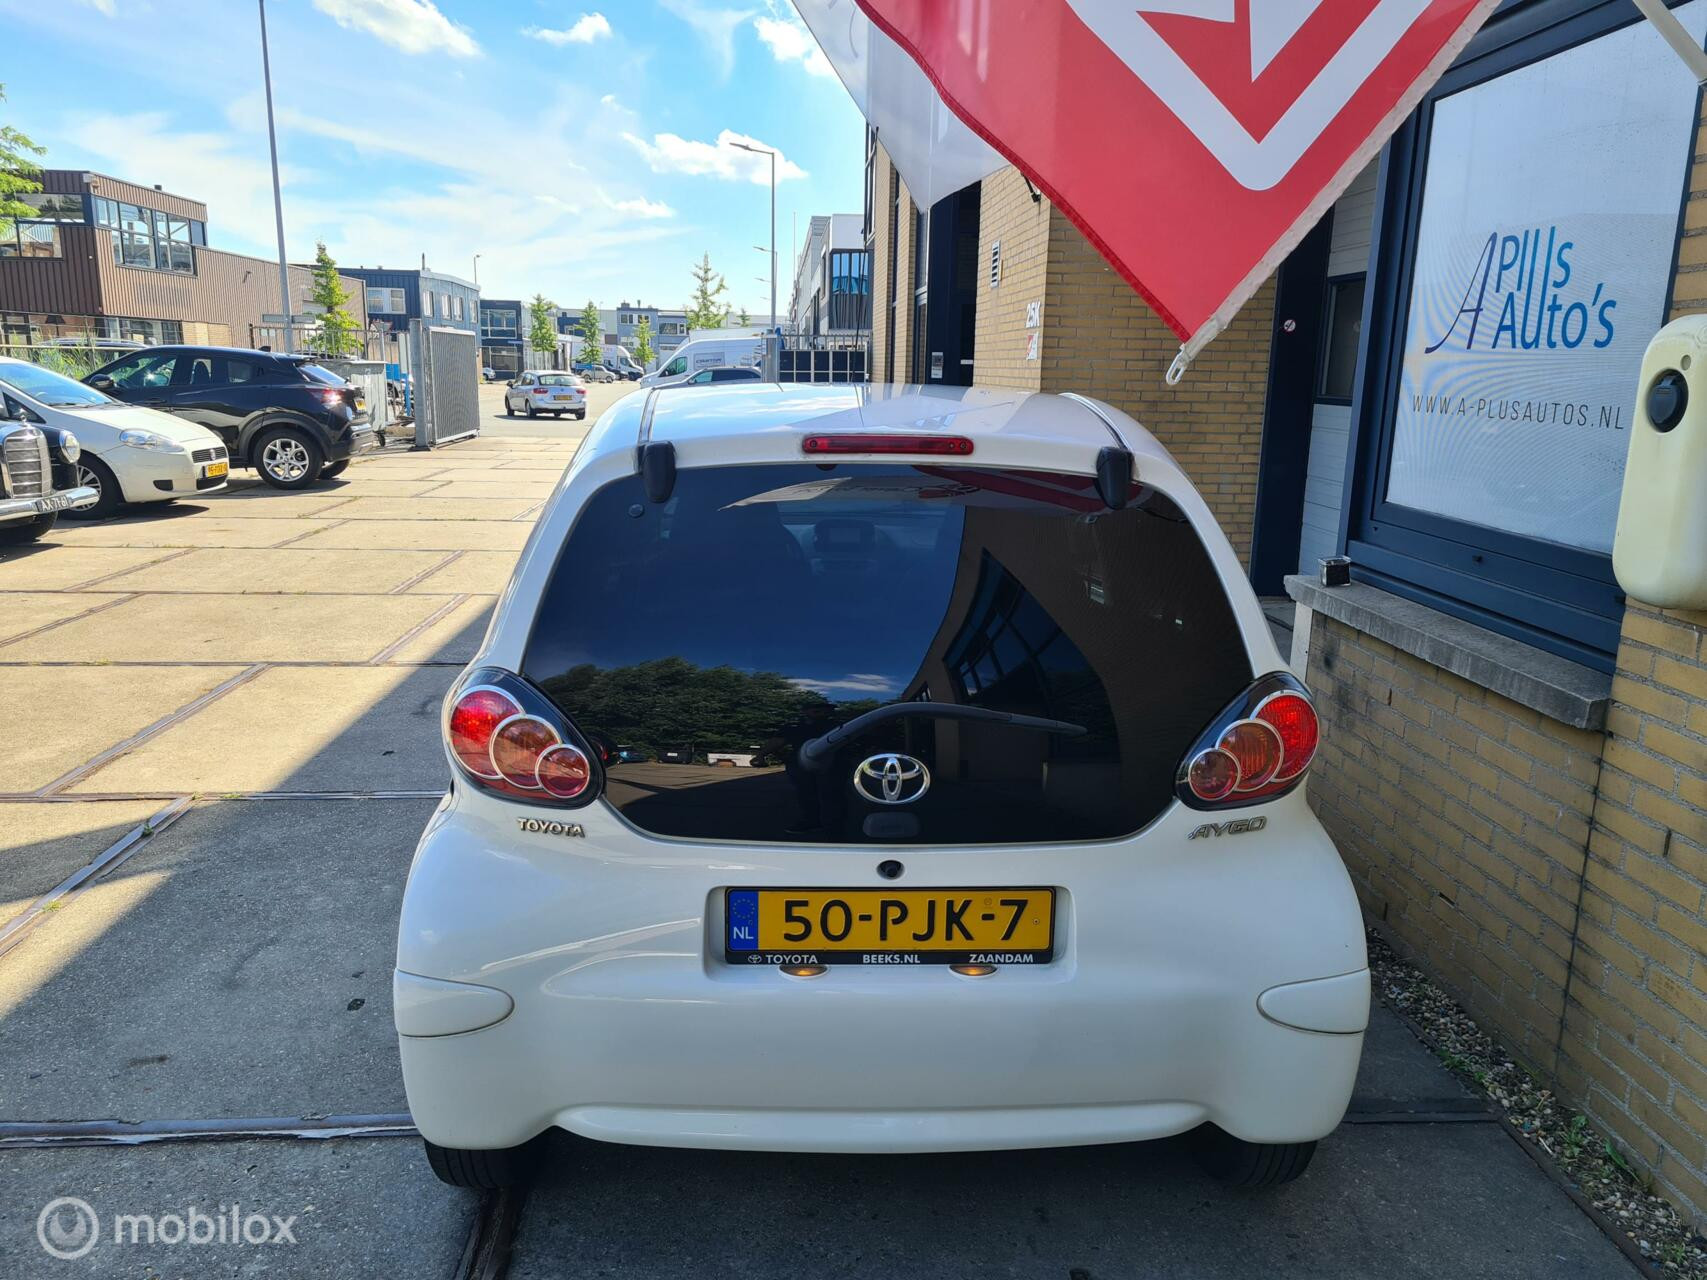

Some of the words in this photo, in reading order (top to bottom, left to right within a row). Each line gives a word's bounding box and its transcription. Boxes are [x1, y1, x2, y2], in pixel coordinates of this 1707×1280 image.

[1411, 394, 1625, 430] WWW.A-PLUSAUTOS.NL
[517, 816, 586, 838] TOYOTA
[1187, 815, 1268, 840] AYGO
[732, 926, 754, 940] NL
[782, 899, 1030, 942] 50-PJK-7
[765, 954, 818, 965] TOYOTA
[862, 954, 921, 965] BEEKS.NL
[968, 953, 1034, 964] ZAANDAM
